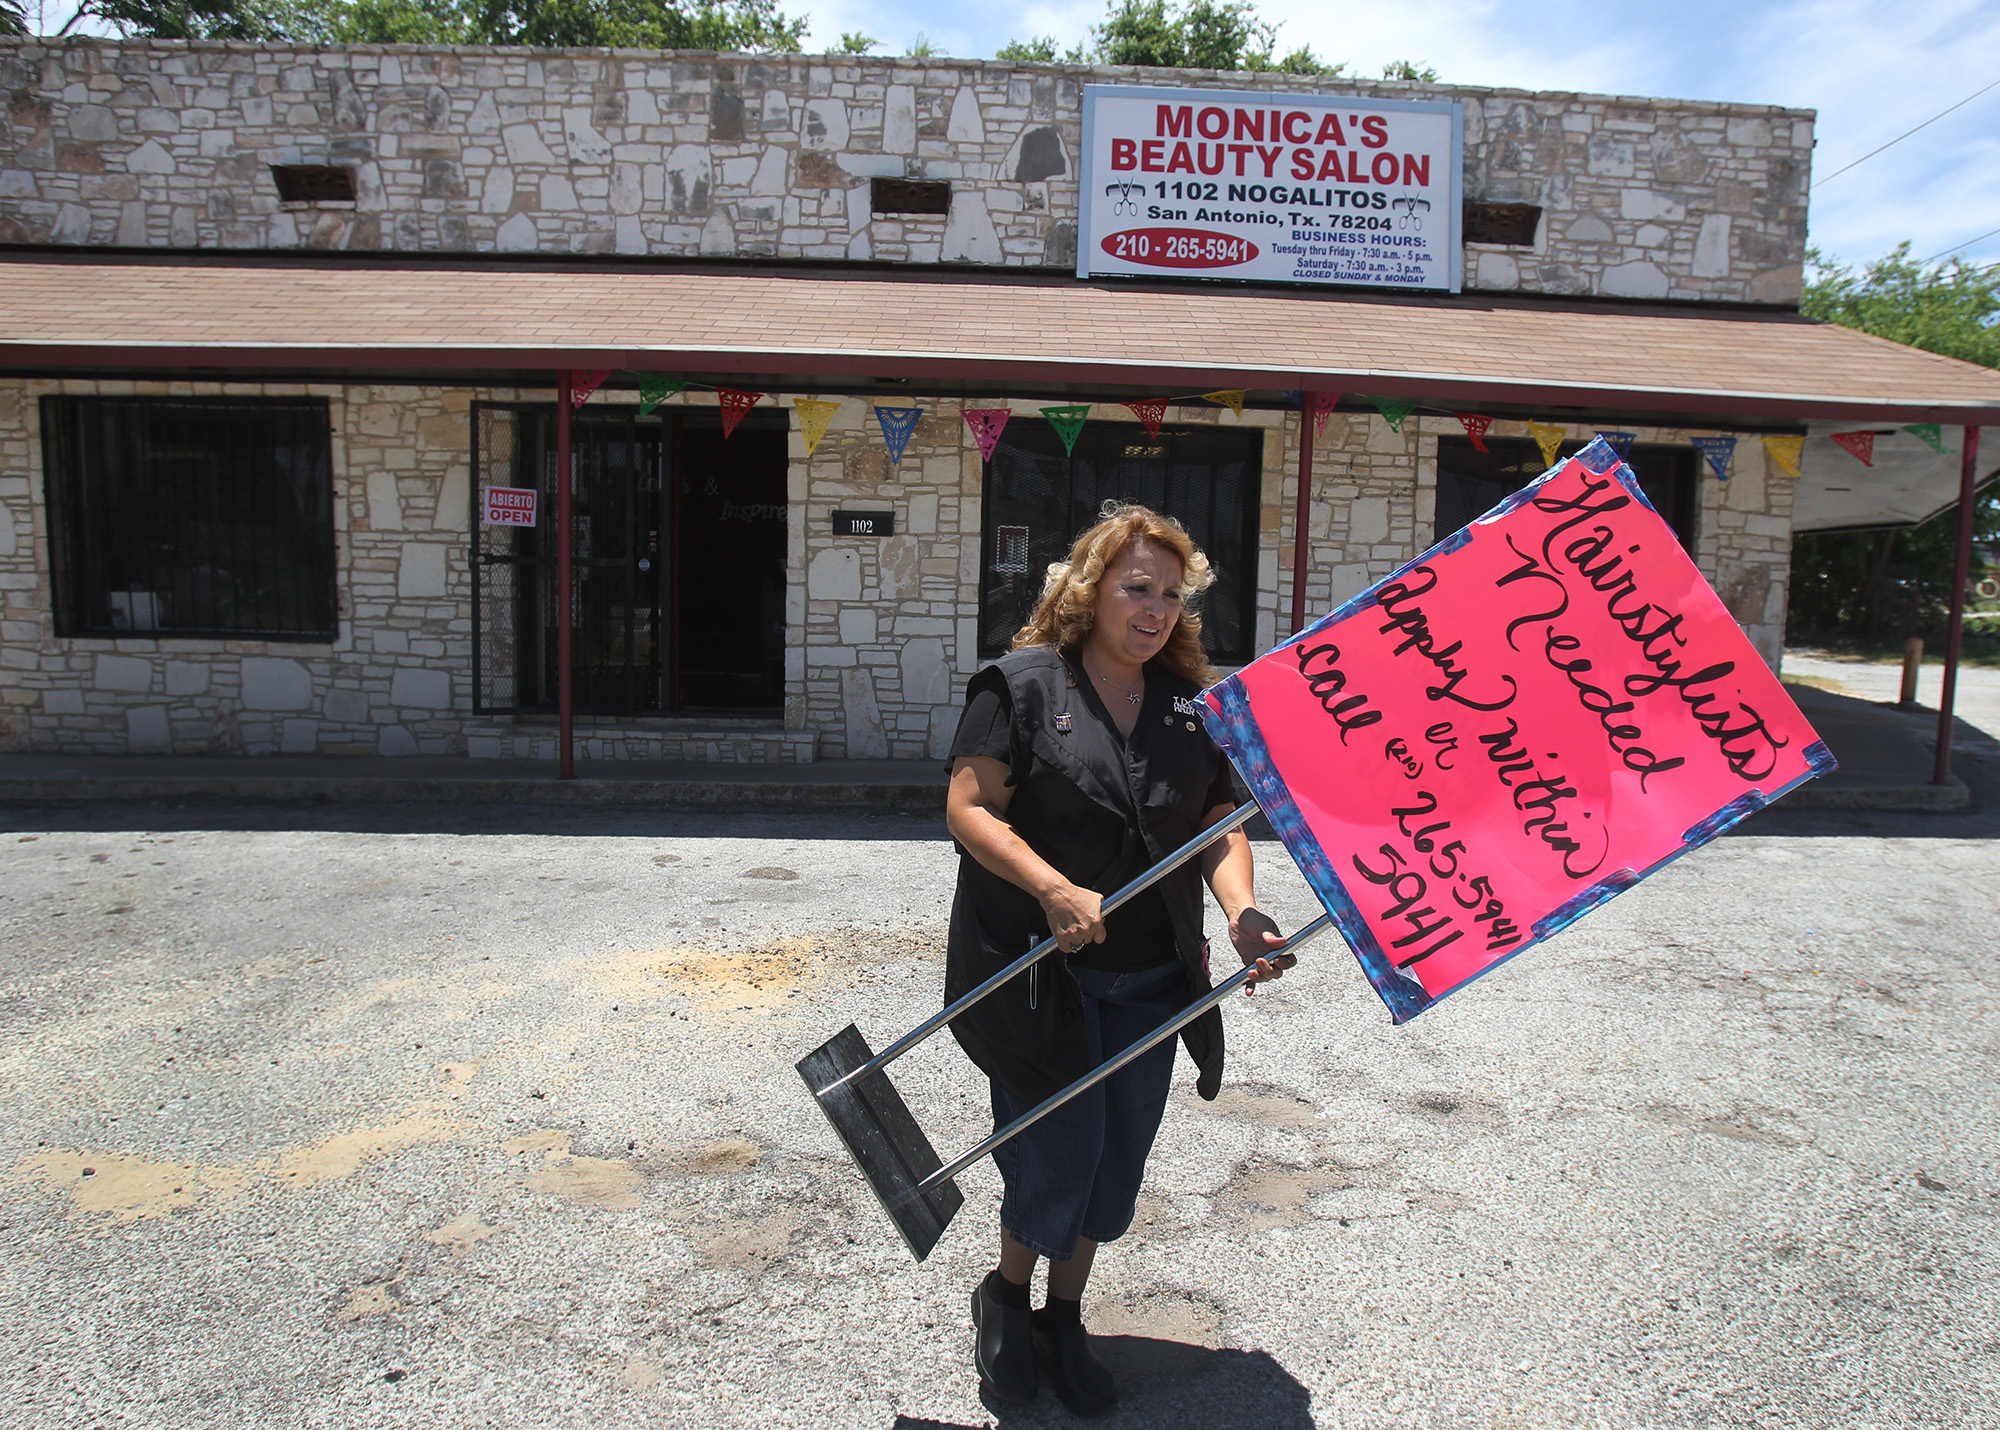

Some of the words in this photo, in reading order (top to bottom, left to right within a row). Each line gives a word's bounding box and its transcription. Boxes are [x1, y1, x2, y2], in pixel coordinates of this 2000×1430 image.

[1156, 104, 1389, 149] MONICA'S
[1111, 138, 1284, 178] BEAUTY
[1290, 147, 1430, 187] SALON
[1154, 181, 1218, 201] 1102
[1228, 184, 1388, 210] NOGALITOS
[1147, 205, 1187, 221] San
[1194, 207, 1284, 228] Antonio,
[1288, 212, 1321, 227] Tx.
[1328, 214, 1393, 231] 78204
[1115, 234, 1150, 257] 210
[1165, 236, 1248, 262] 265-5941
[1292, 230, 1366, 244] BUSINESS
[1371, 234, 1427, 248] HOURS:
[1271, 243, 1307, 257] Tuesday
[1309, 245, 1327, 256] thru
[1328, 245, 1356, 259] Friday
[1363, 247, 1381, 259] 7:30
[1382, 250, 1401, 260] a.m.
[1408, 250, 1414, 261] 5
[1415, 252, 1433, 262] p.m.
[1292, 269, 1332, 280] CLOSED
[1333, 271, 1373, 281] SUNDAY
[1374, 273, 1382, 281] &
[1384, 274, 1426, 283] MONDAY
[1297, 257, 1339, 271] Saturday
[1346, 260, 1366, 271] 7:30
[1369, 262, 1389, 272] a.m.
[1396, 263, 1402, 273] 3
[1404, 265, 1424, 276] p.m.
[490, 492, 533, 509] ABIERTO
[490, 509, 532, 524] OPEN
[851, 519, 873, 534] 1102
[1532, 472, 1789, 782] Hairstylists
[1353, 843, 1465, 969] 5941
